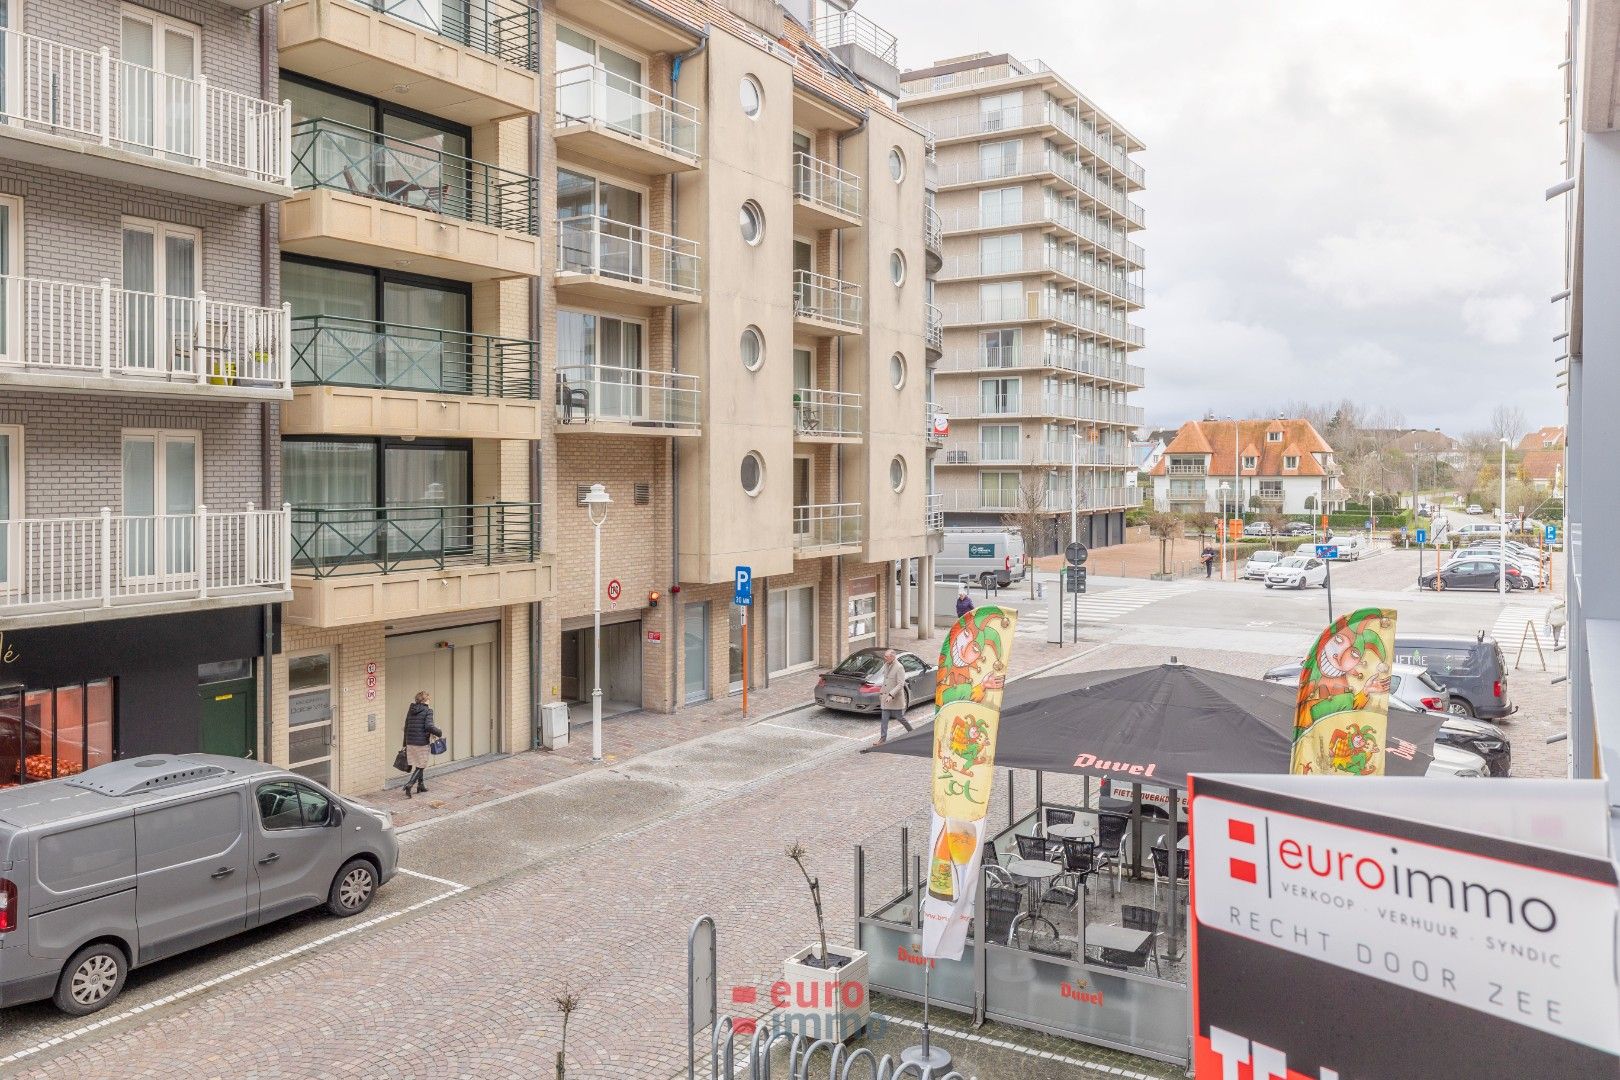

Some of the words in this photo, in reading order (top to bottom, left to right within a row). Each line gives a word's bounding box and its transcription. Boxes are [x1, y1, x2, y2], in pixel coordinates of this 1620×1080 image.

[737, 570, 749, 591] P
[1072, 753, 1157, 777] Duvel
[1278, 839, 1557, 933] euroimmo
[1281, 881, 1354, 910] VERKOOP
[1378, 907, 1459, 939] VERHUUR
[1485, 936, 1562, 969] SYNDIC
[1229, 906, 1331, 952] RECHT
[1356, 943, 1457, 991] DOOR
[1488, 981, 1563, 1025] ZEE
